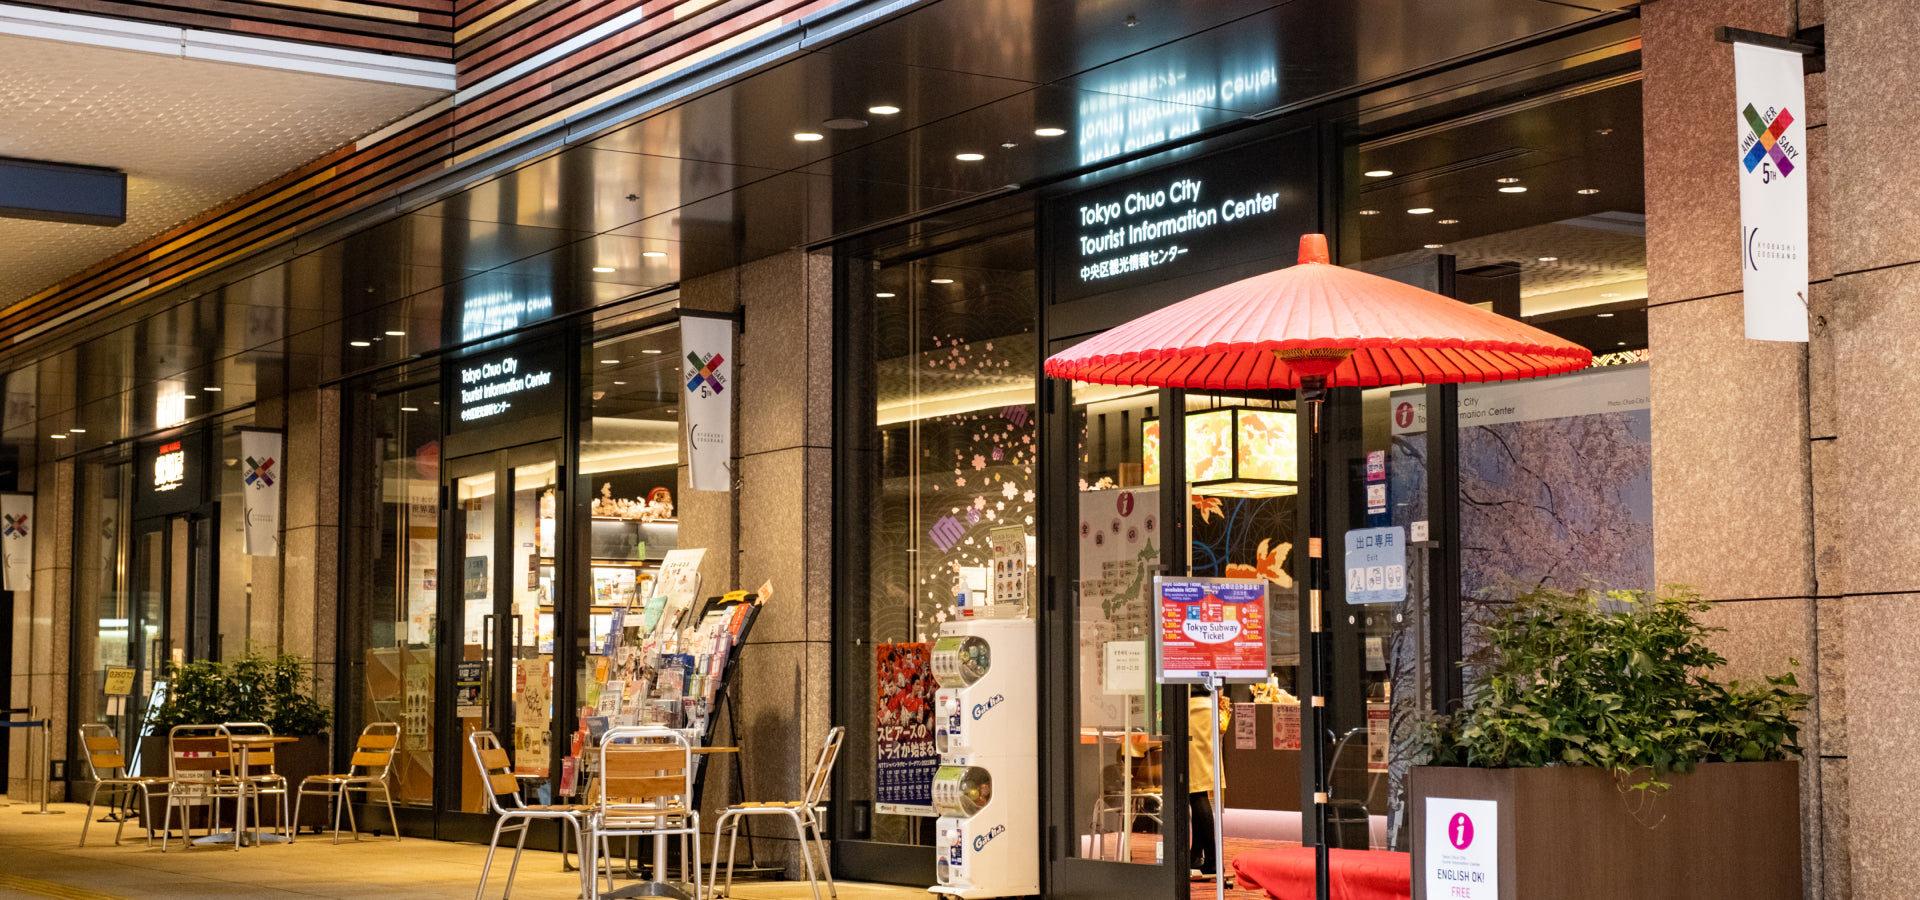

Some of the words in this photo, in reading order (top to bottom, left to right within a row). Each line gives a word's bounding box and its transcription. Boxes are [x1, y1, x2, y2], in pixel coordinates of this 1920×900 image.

[1762, 106, 1777, 125] VER
[1741, 130, 1757, 154] ANNI
[1778, 135, 1799, 160] SARY
[1762, 162, 1777, 185] 5TH
[1080, 201, 1121, 226] Tokyo
[1124, 190, 1166, 215] Chuo
[1169, 178, 1202, 203] City
[1080, 227, 1125, 256] Tourist
[1129, 206, 1217, 244] Information
[1221, 192, 1280, 222] Center
[1080, 245, 1188, 282] 中央区観光情報センター
[461, 368, 482, 384] Tokyo
[482, 363, 502, 379] Chuo
[502, 357, 518, 374] City
[461, 385, 483, 404] Tourist
[483, 377, 524, 399] Information
[525, 371, 552, 389] Center
[1463, 397, 1479, 407] City
[1488, 406, 1515, 417] Center
[1356, 533, 1393, 549] 出口専用
[1366, 553, 1378, 562] Exit
[1186, 622, 1208, 633] Tokyo
[1209, 623, 1238, 634] Subway
[1202, 632, 1225, 640] Ticket
[877, 723, 927, 742] スピアーズの
[878, 741, 938, 760] トライが始まる。
[1437, 868, 1470, 882] ENGLISH
[1472, 871, 1485, 884] OK!
[1451, 886, 1471, 899] FREE
